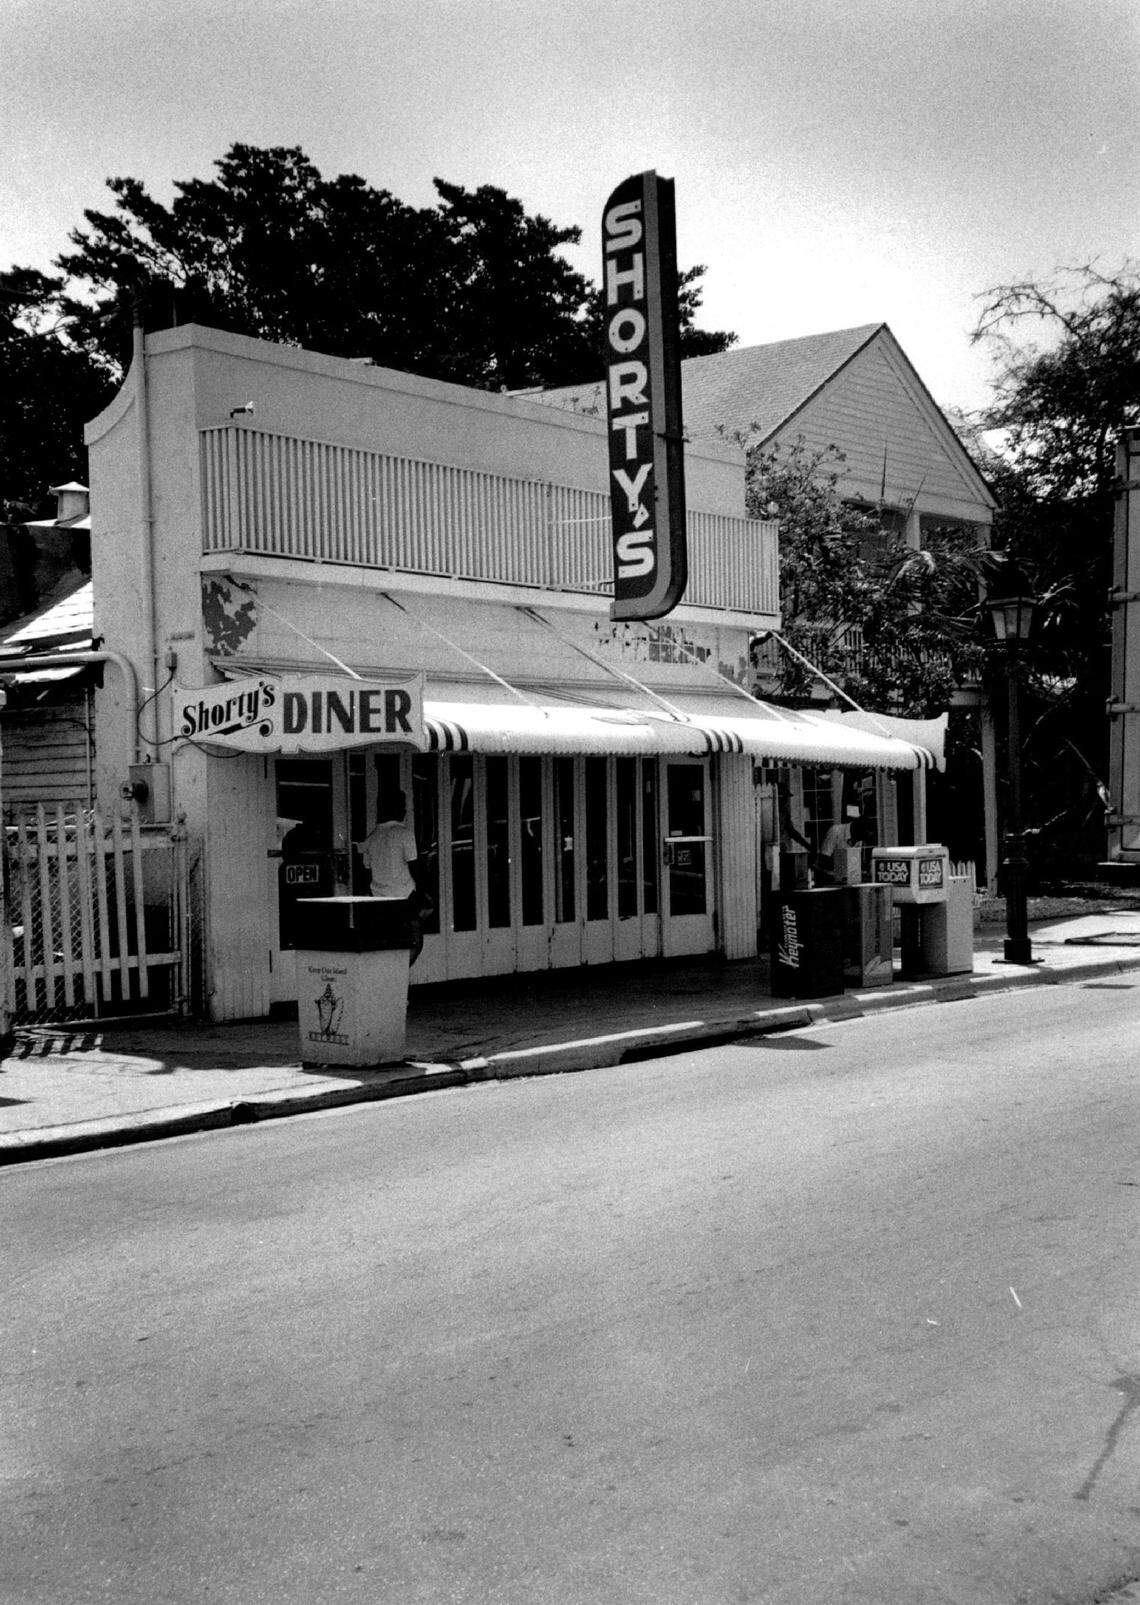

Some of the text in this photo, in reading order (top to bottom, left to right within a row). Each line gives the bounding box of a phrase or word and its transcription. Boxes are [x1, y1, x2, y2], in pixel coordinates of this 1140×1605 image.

[605, 199, 655, 579] SHORTY'S
[181, 680, 413, 737] Shorty's DINER
[886, 862, 908, 872] USA
[926, 861, 941, 872] USA
[286, 865, 319, 884] OPEN
[878, 871, 909, 882] TODAY
[920, 873, 942, 884] TODAY
[779, 904, 804, 968] Keynoter
